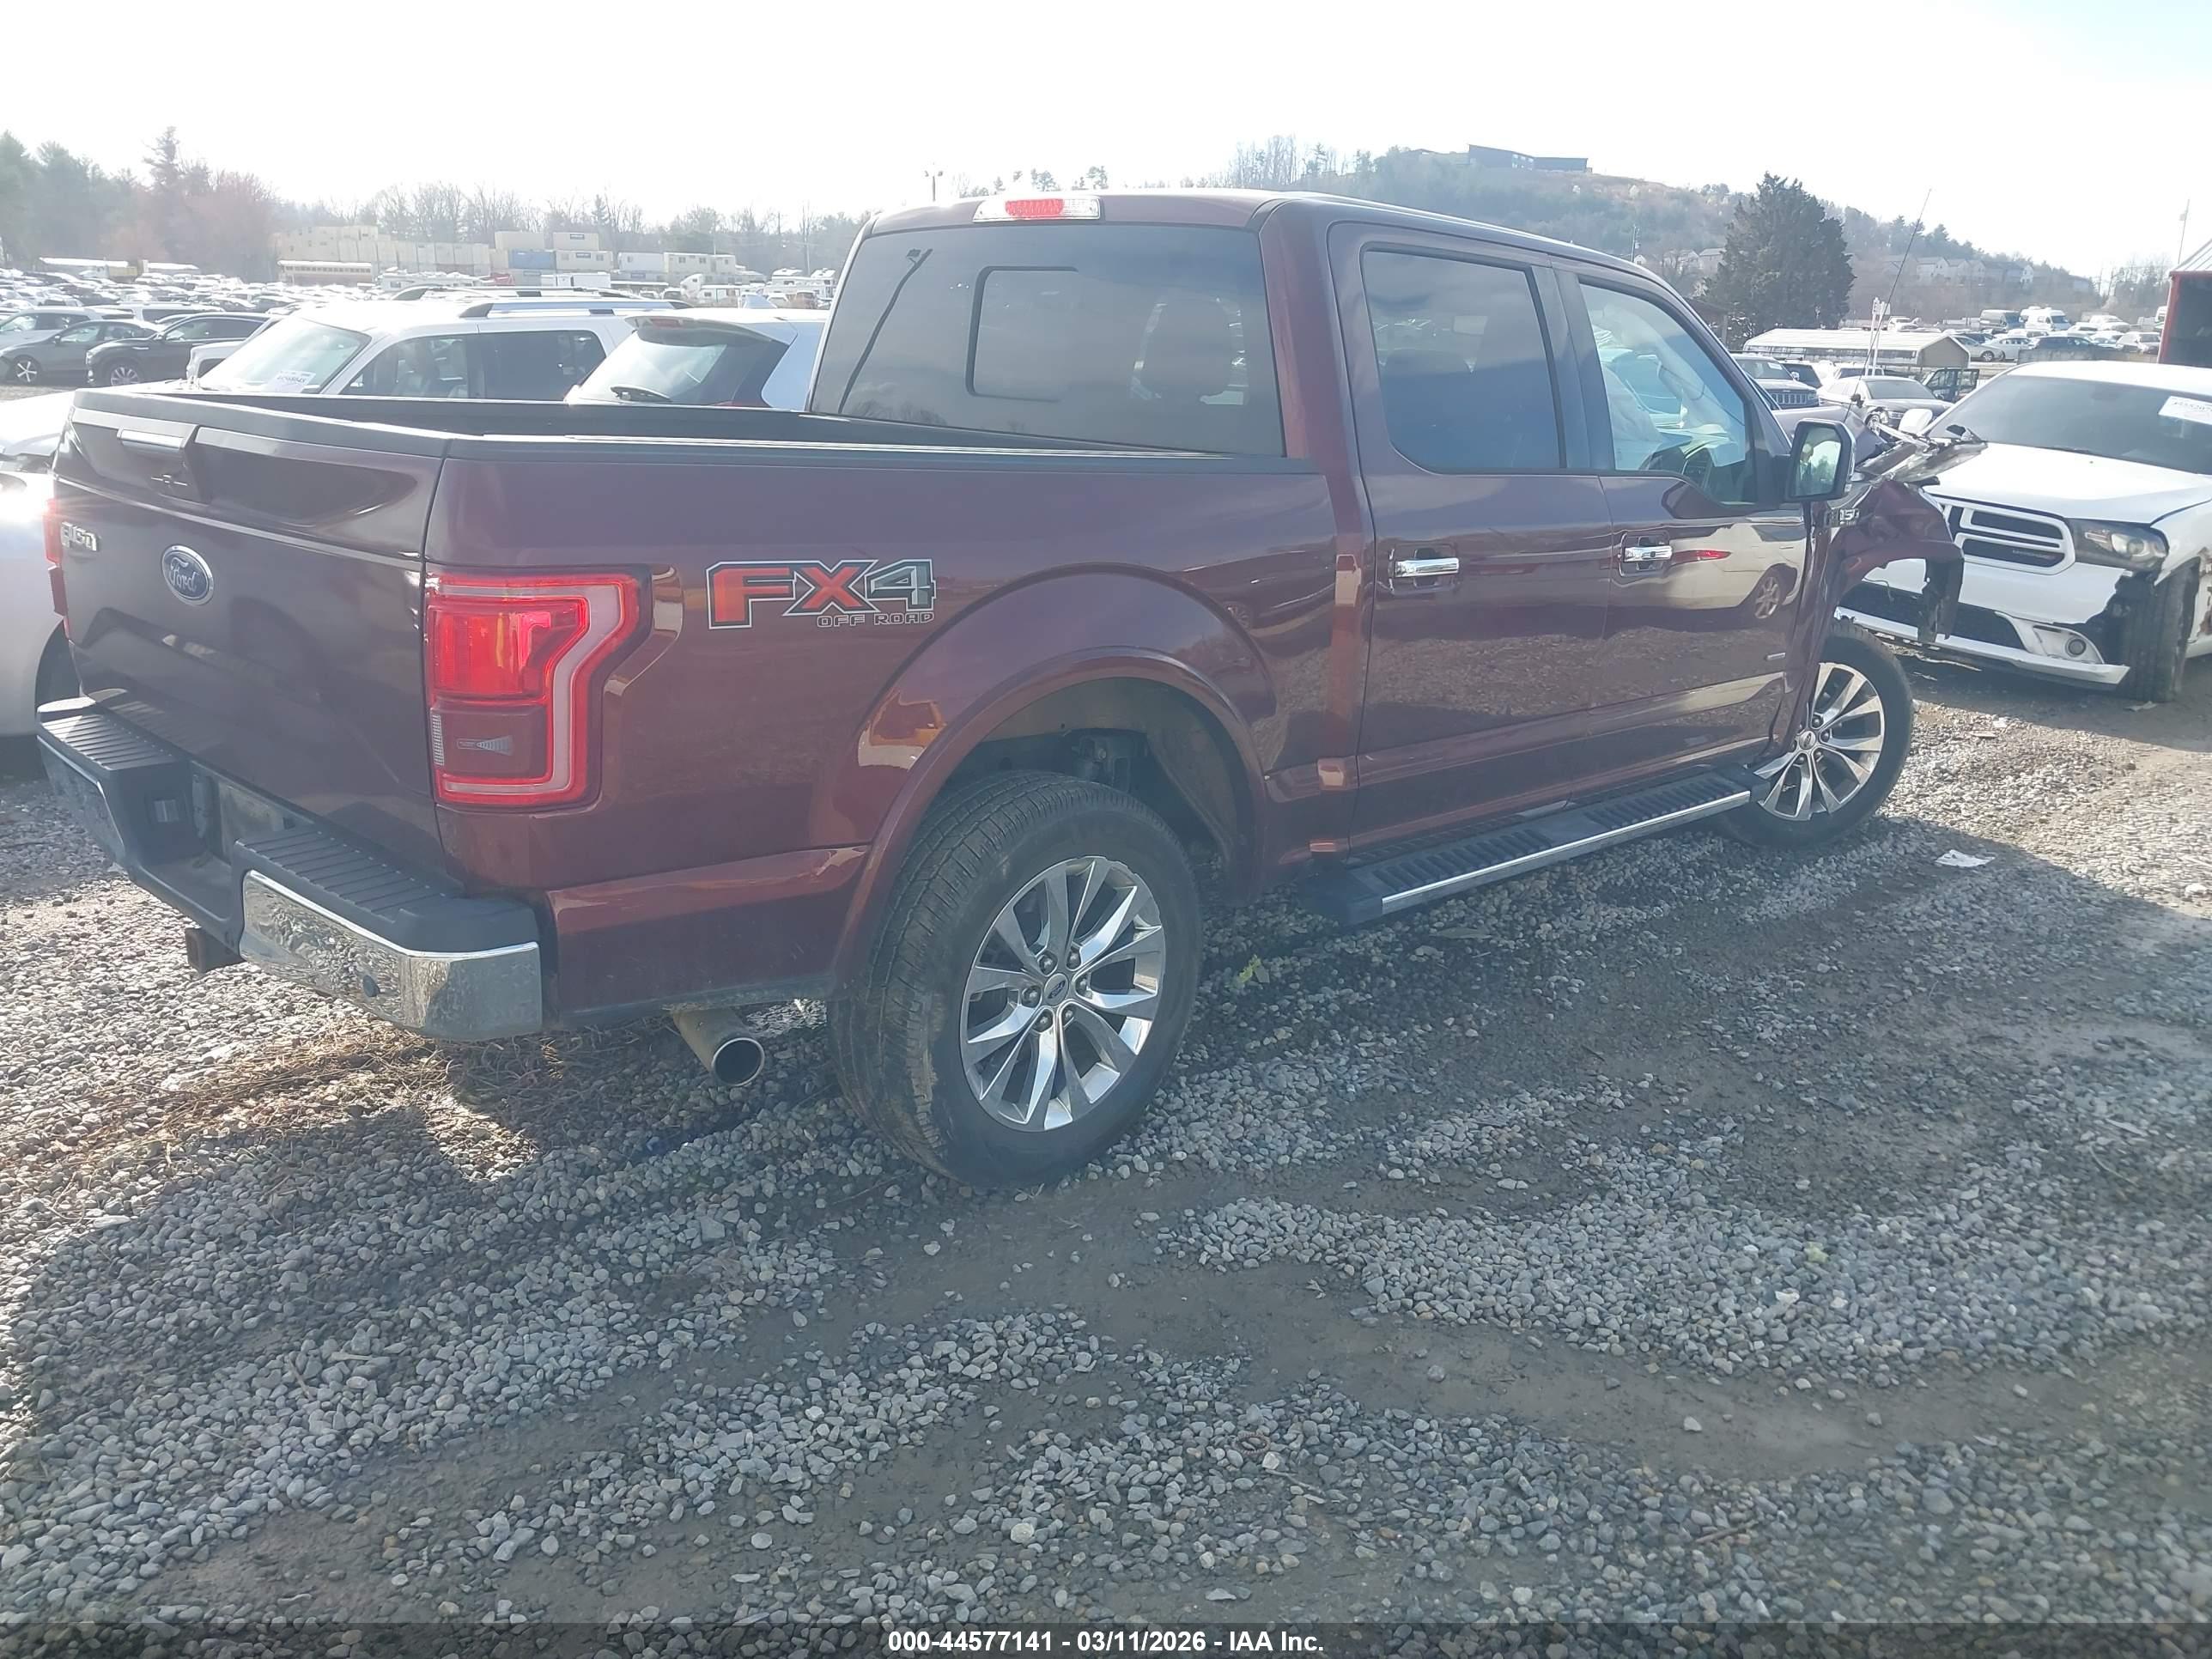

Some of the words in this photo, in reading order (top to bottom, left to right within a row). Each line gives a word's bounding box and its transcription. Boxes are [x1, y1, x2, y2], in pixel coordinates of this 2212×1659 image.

[170, 556, 199, 592] Ford
[706, 559, 937, 629] FX4
[817, 615, 866, 627] OFF
[874, 611, 935, 626] ROAD
